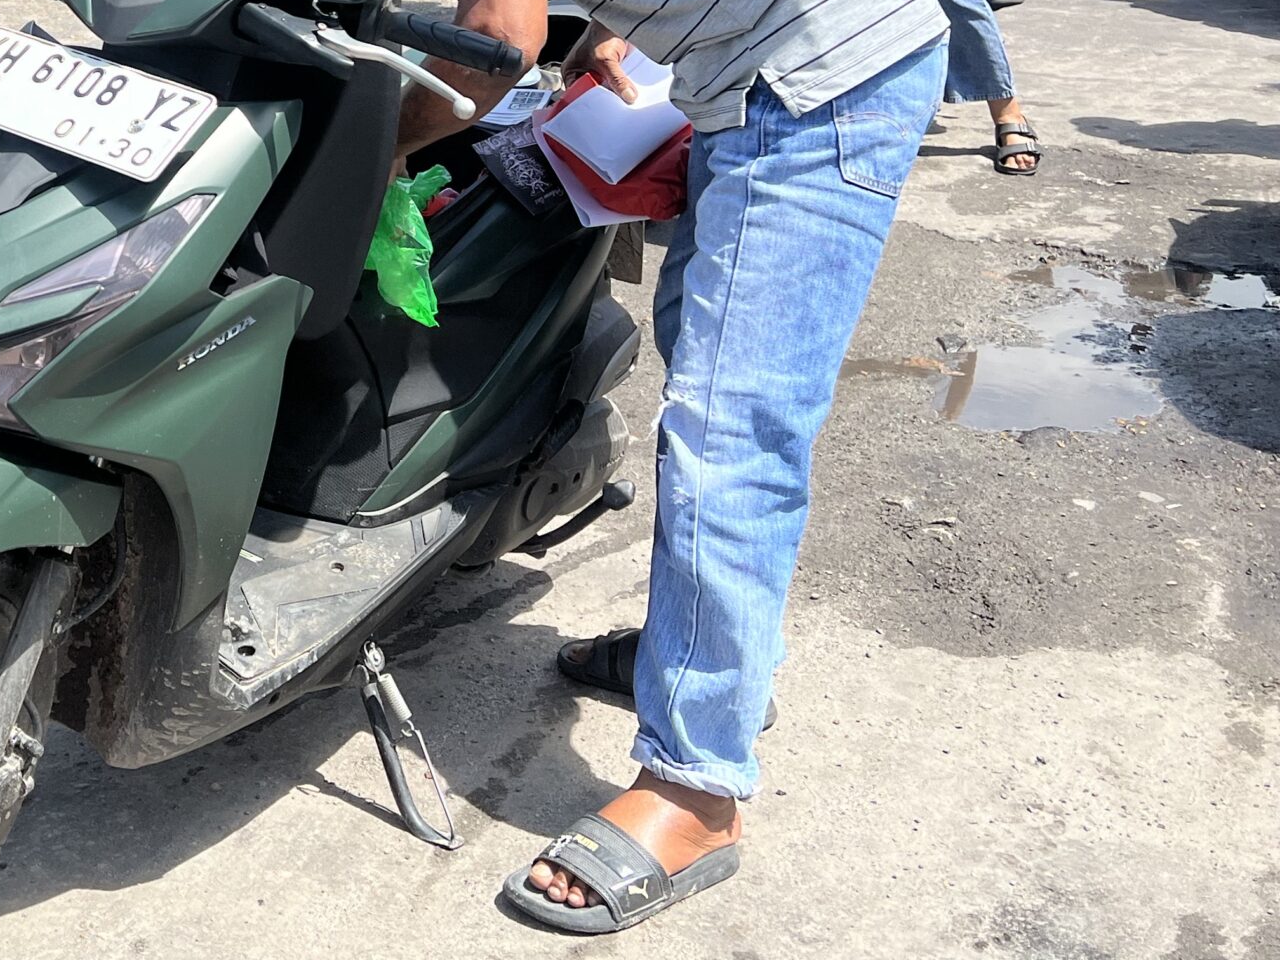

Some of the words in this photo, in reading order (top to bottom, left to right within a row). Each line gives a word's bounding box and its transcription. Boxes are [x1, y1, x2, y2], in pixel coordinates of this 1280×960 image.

[31, 53, 128, 106] 6108
[143, 88, 202, 133] YZ
[177, 315, 257, 371] HONDA
